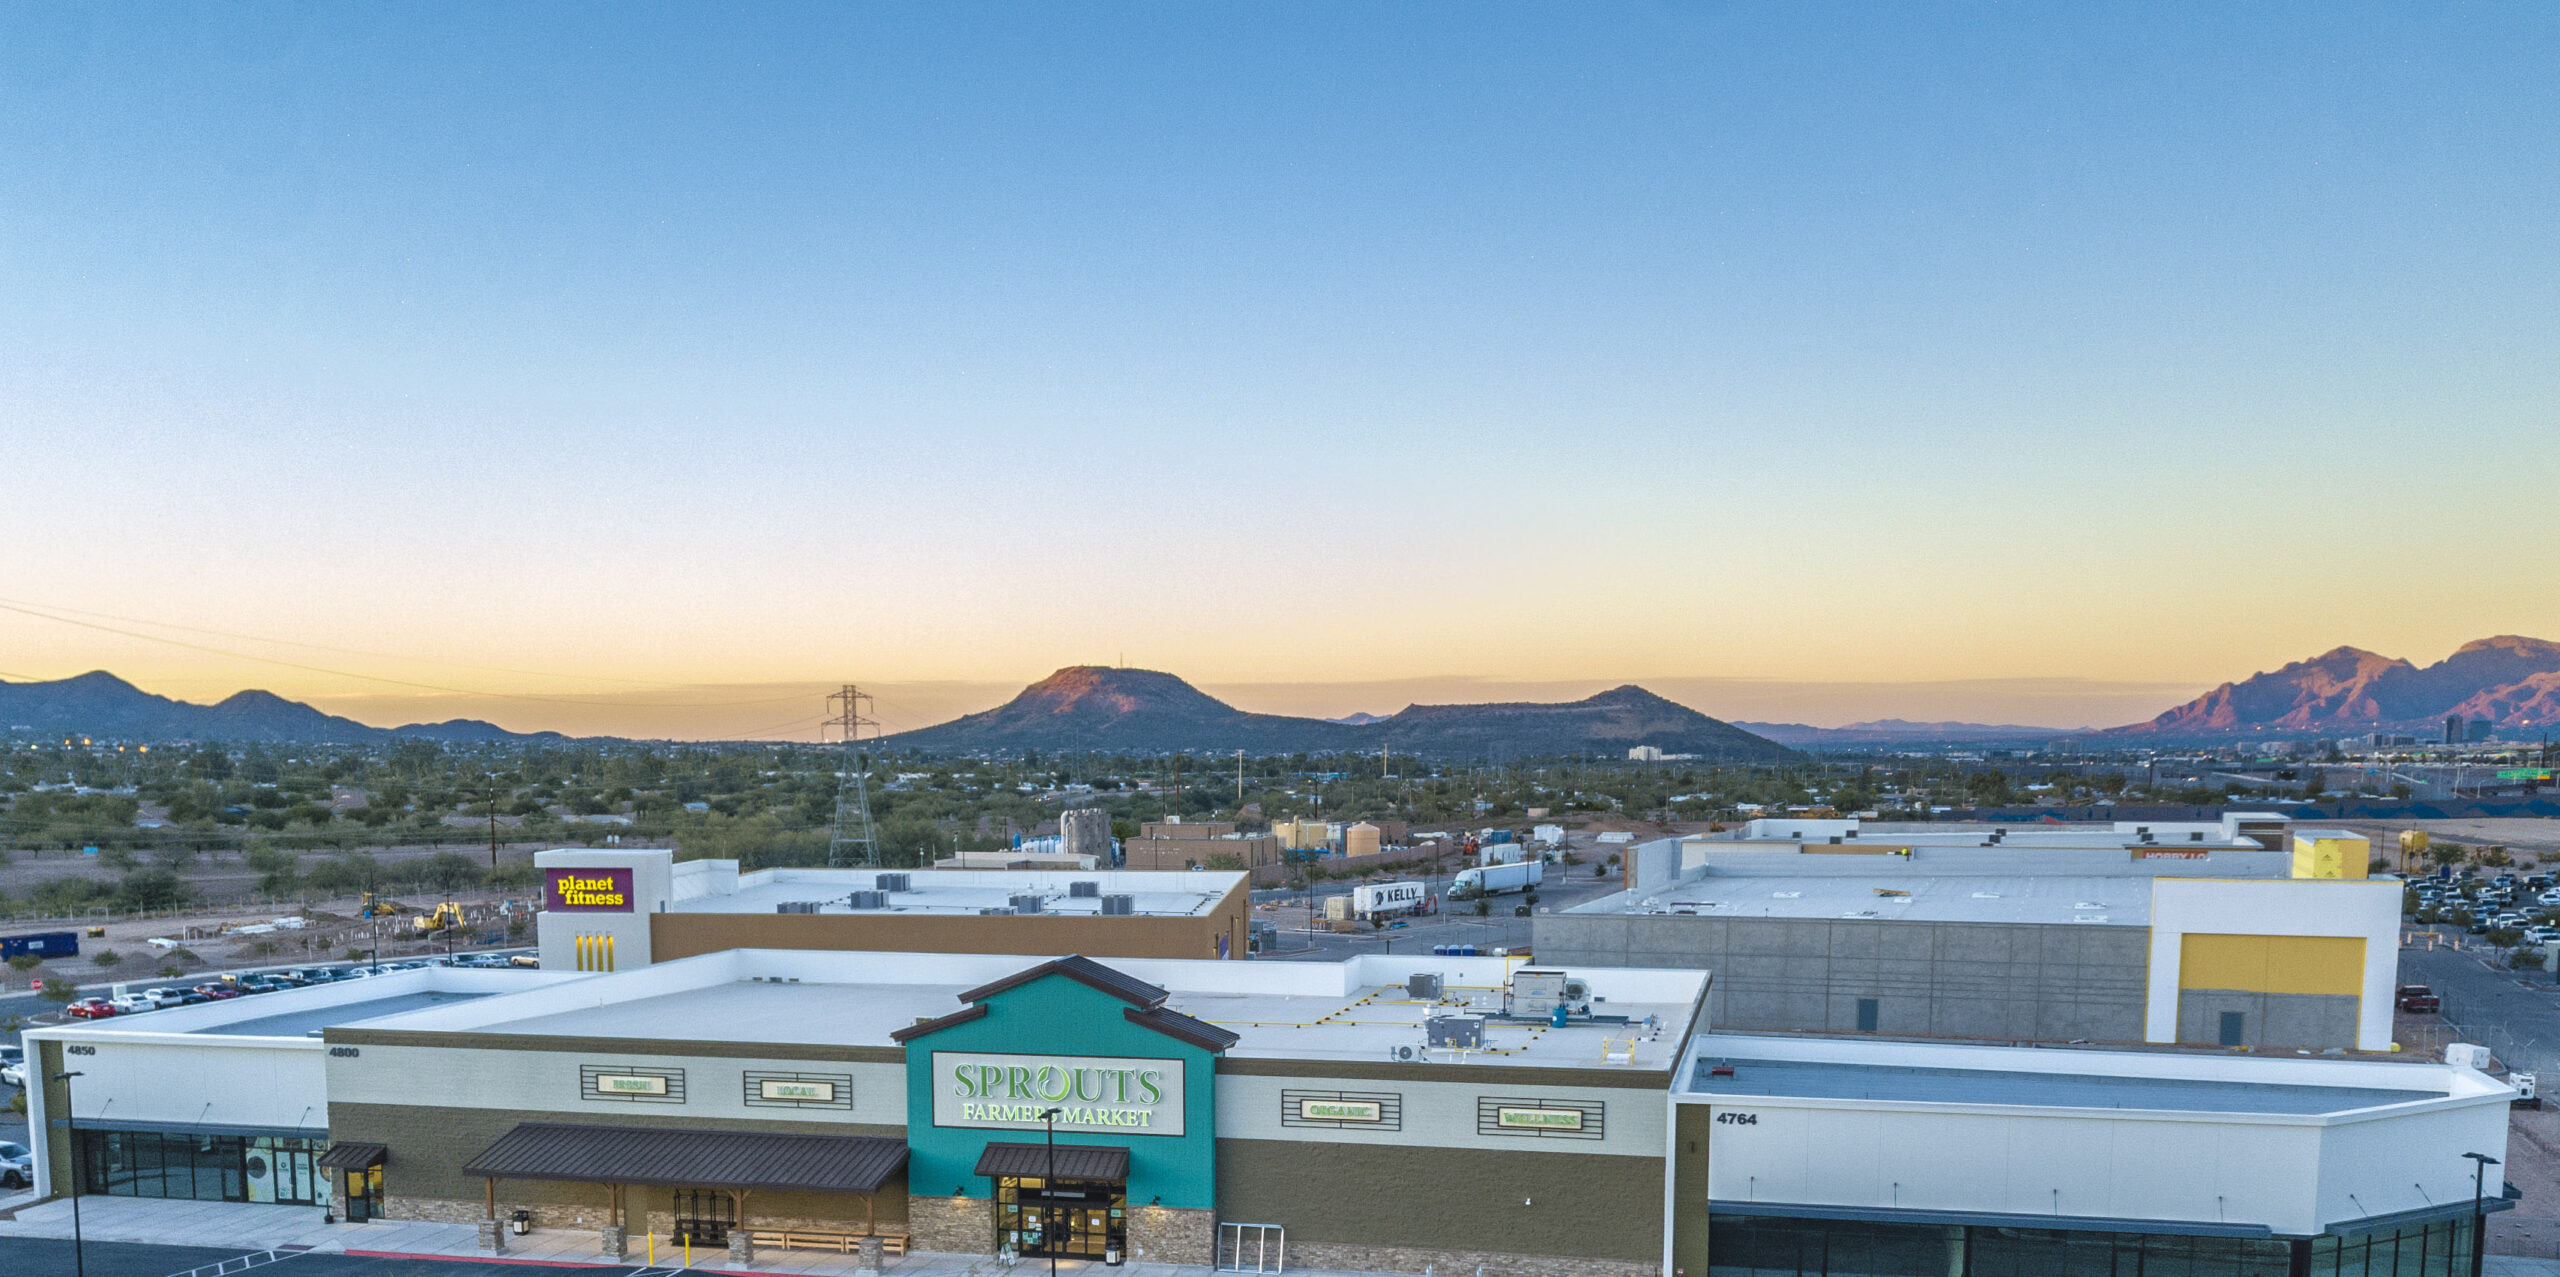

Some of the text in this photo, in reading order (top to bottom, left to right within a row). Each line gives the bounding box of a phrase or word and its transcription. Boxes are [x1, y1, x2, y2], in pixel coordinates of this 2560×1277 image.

[558, 875, 614, 894] planet
[565, 890, 624, 905] fitness
[1387, 887, 1418, 903] KELLY
[67, 1045, 96, 1056] 4850
[329, 1047, 360, 1058] 4800
[954, 1063, 1162, 1105] SPROUTS
[1063, 1106, 1152, 1127] MARKET
[1310, 1104, 1372, 1117] ORGANIC
[1503, 1112, 1578, 1126] WELLNESS
[1716, 1112, 1758, 1126] 4764
